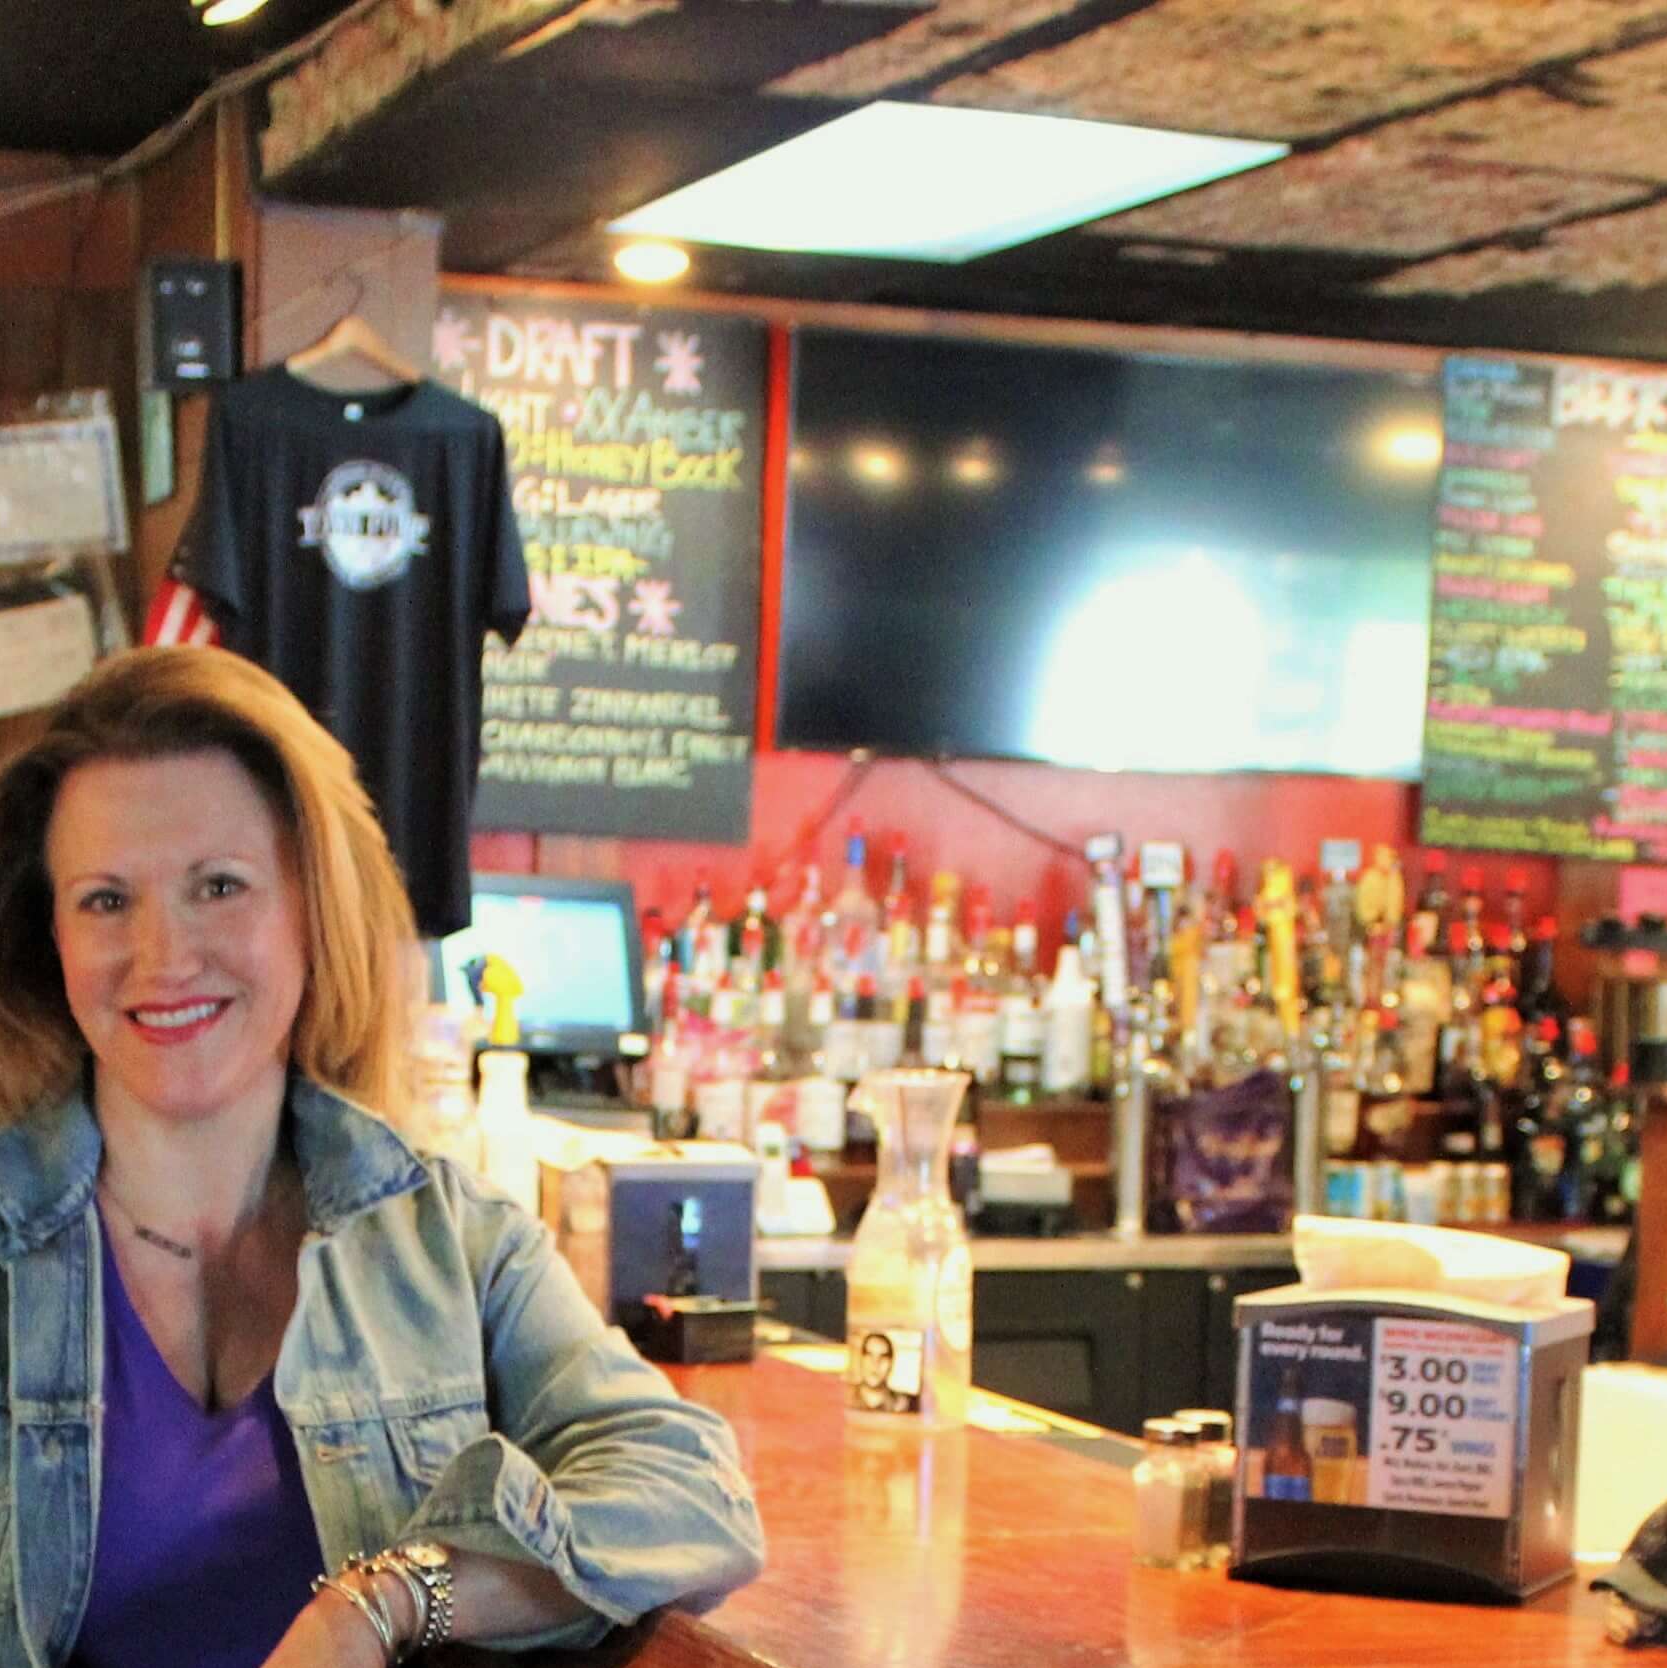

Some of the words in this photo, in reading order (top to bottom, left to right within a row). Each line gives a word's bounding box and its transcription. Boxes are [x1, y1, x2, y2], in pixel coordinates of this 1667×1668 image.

[487, 318, 641, 388] DRAFT
[528, 570, 621, 631] NES
[1260, 1321, 1316, 1344] Ready
